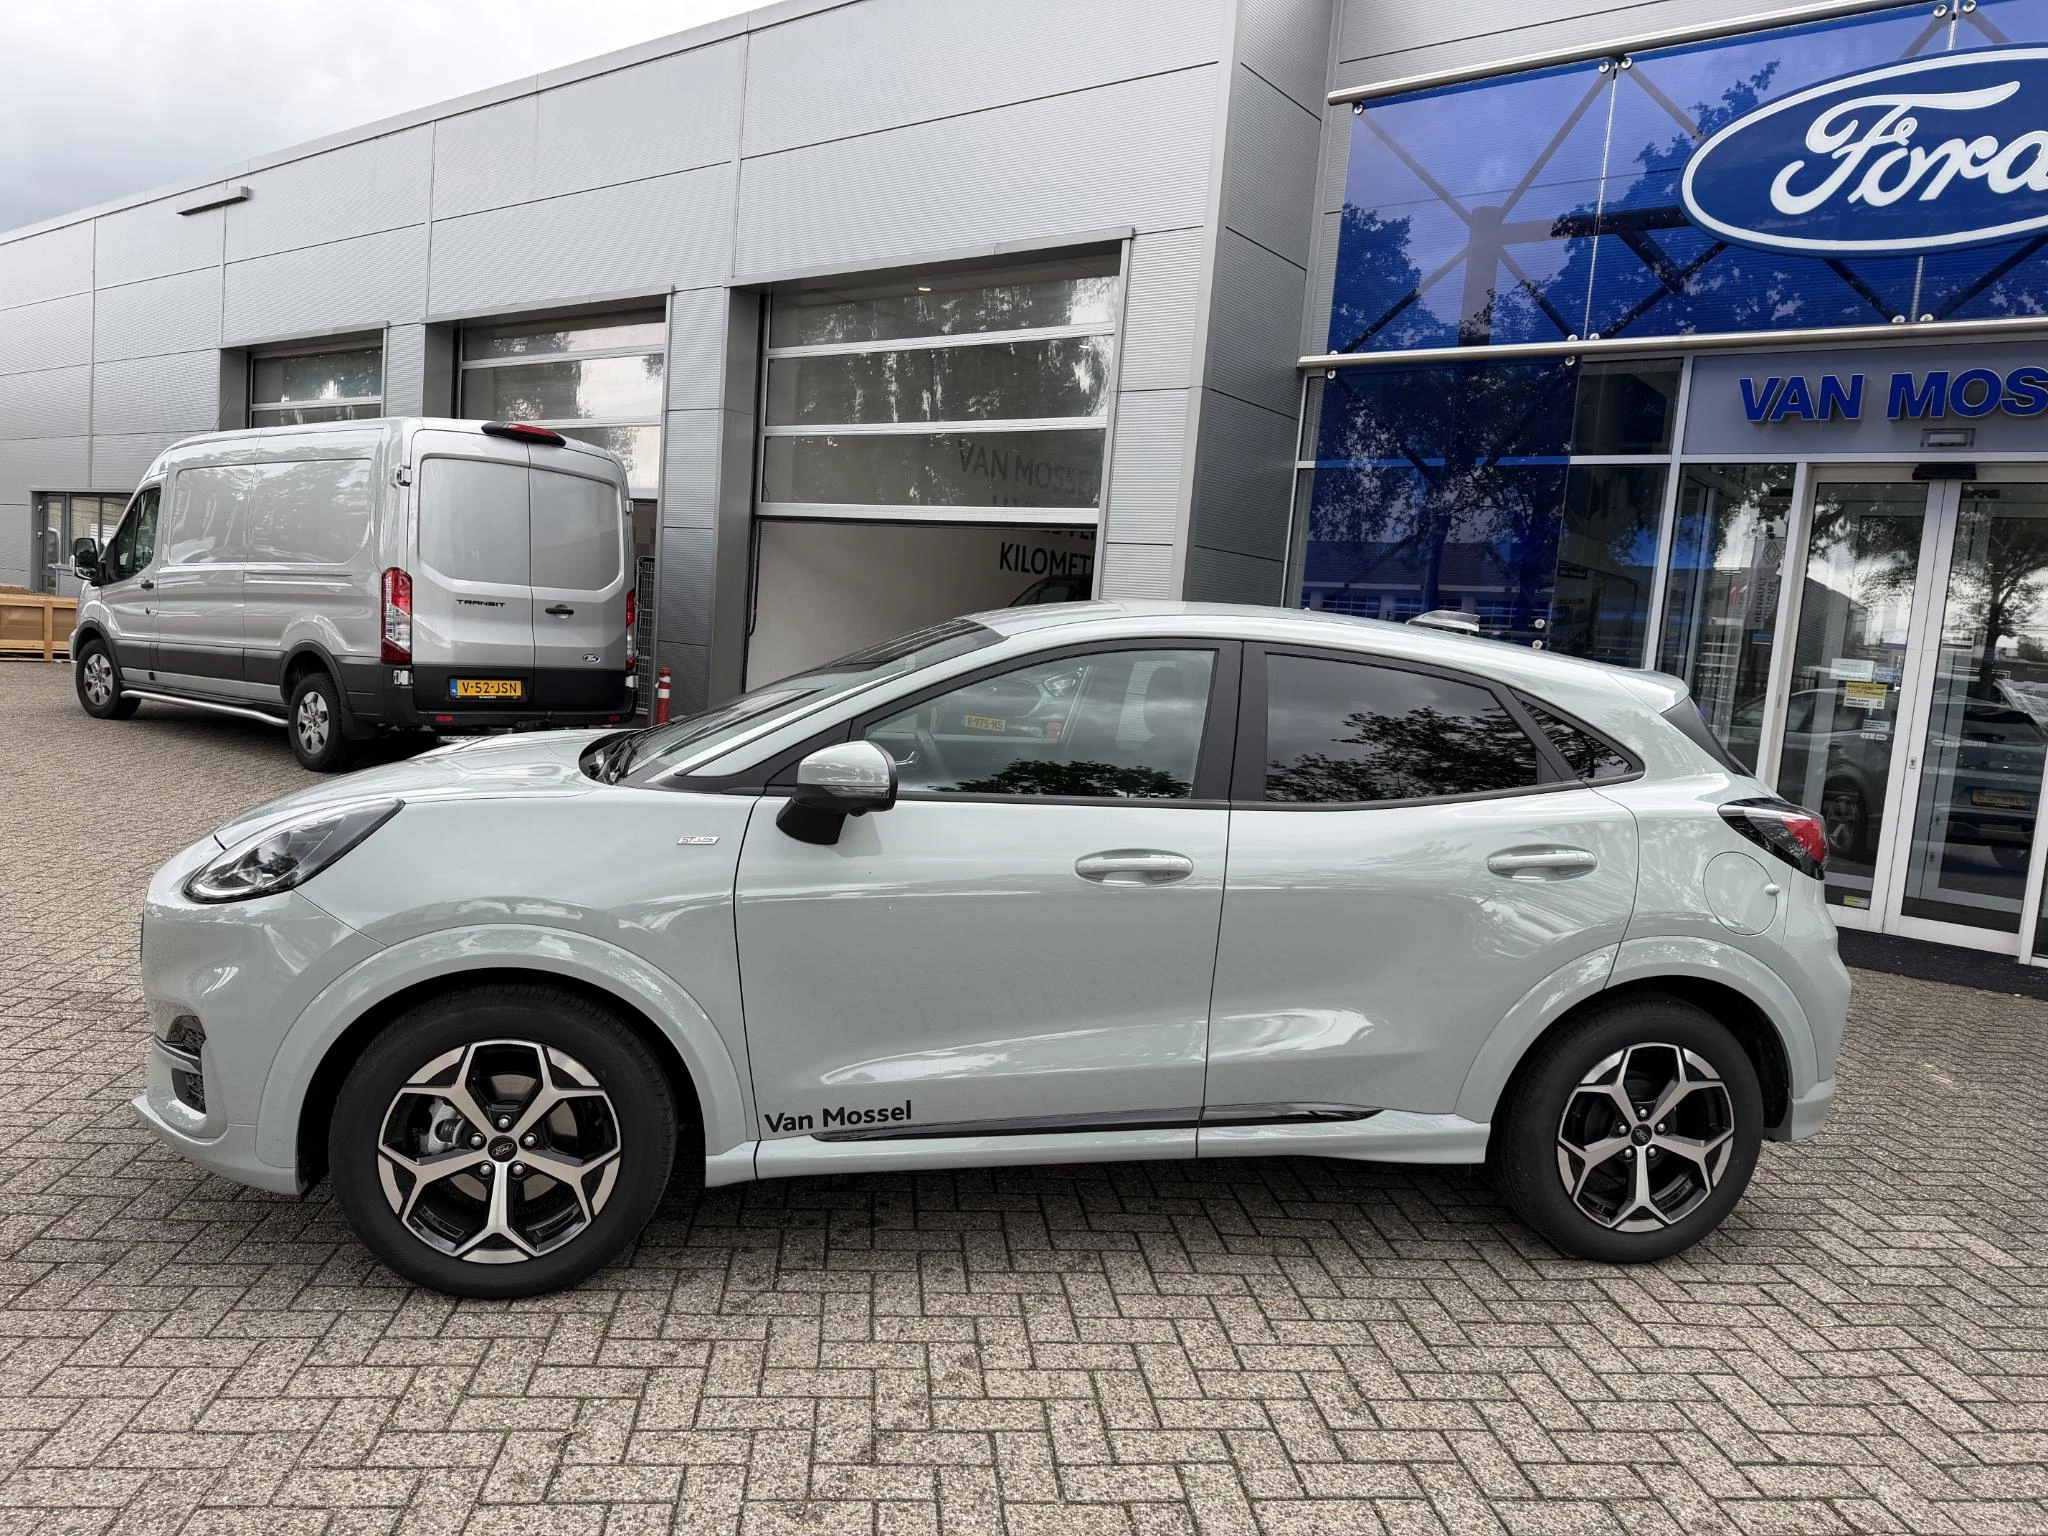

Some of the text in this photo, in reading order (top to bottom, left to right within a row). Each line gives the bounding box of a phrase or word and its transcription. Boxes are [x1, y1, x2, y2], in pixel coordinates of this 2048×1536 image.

[1770, 81, 2048, 215] Ford
[1738, 366, 2048, 422] VAN MOS
[958, 440, 1008, 480] VAN
[1000, 541, 1096, 577] KILOMET
[455, 599, 506, 608] TRANSIT
[462, 681, 517, 694] V-52-JSN
[764, 1100, 912, 1133] Van Mossel
